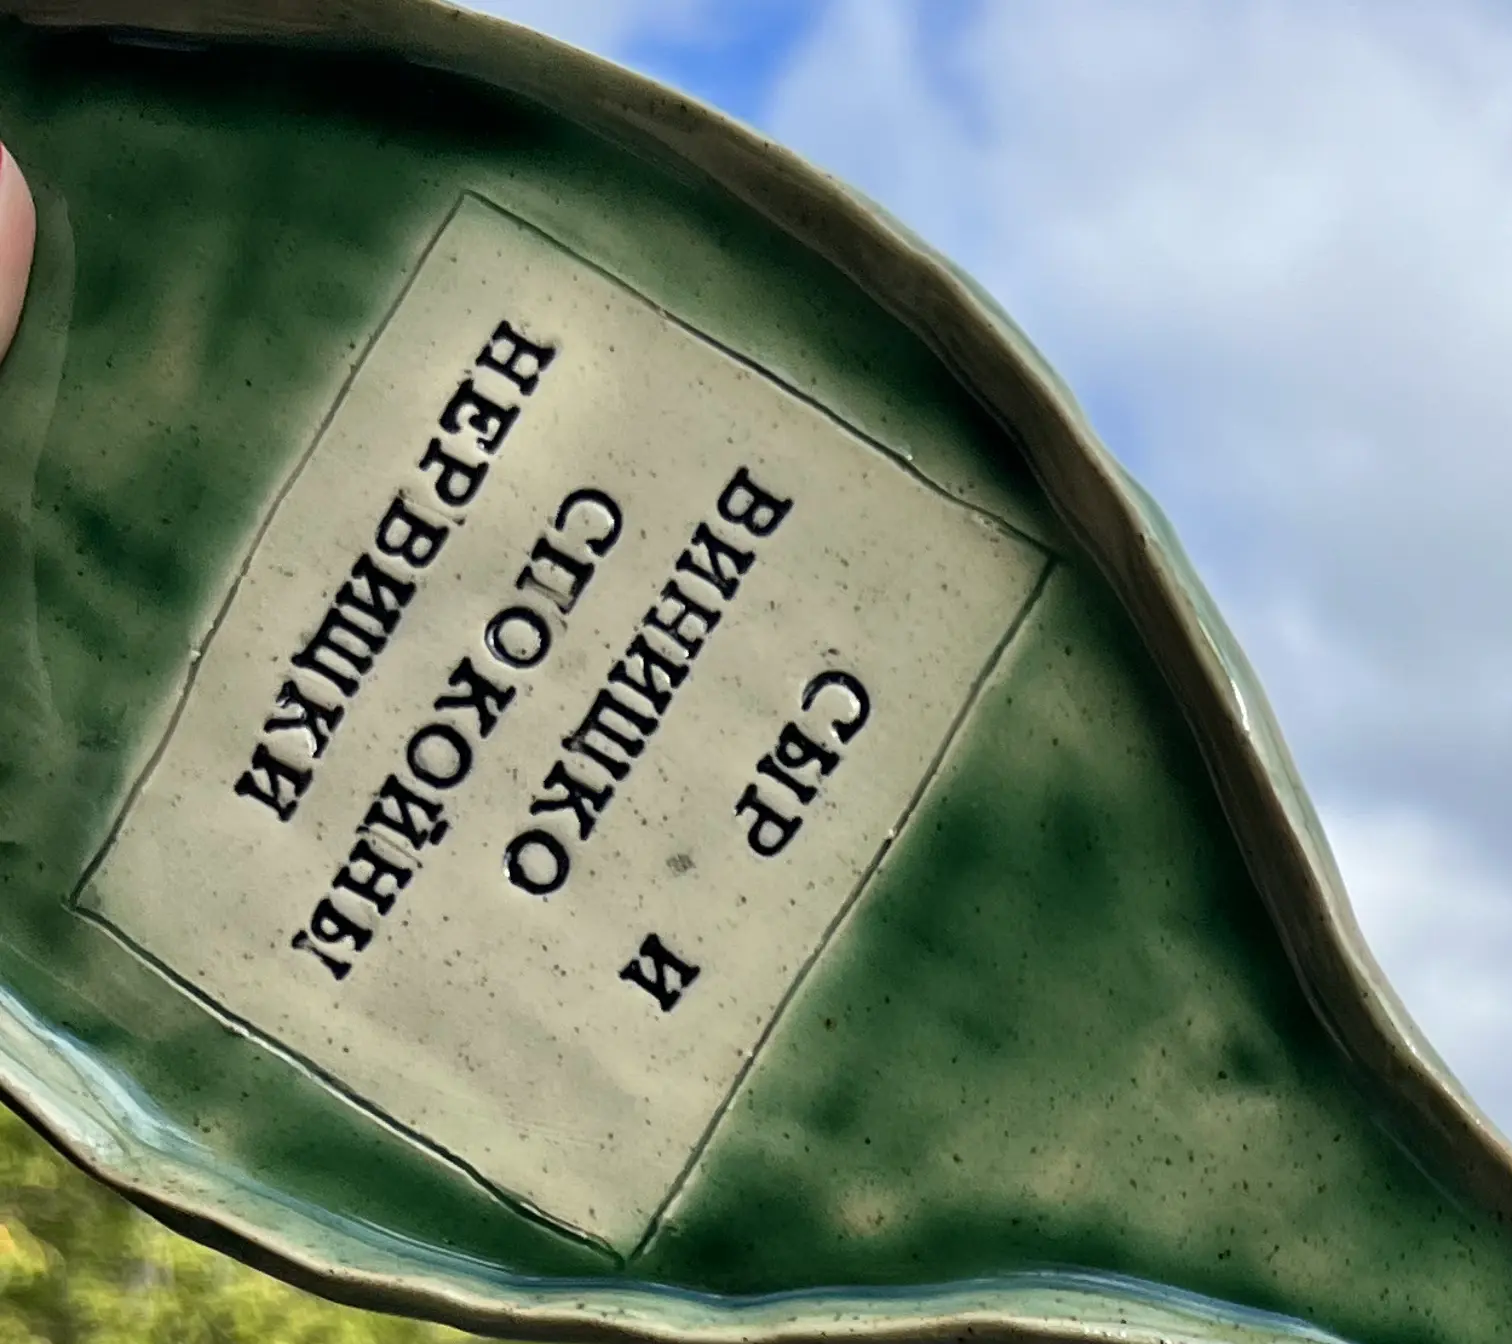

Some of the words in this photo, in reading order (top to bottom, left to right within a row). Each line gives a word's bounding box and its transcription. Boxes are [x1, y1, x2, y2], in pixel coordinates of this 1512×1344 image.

[290, 487, 624, 980] СПОКОЙНЫ
[734, 669, 872, 858] СЫР
[618, 933, 701, 1012] И
